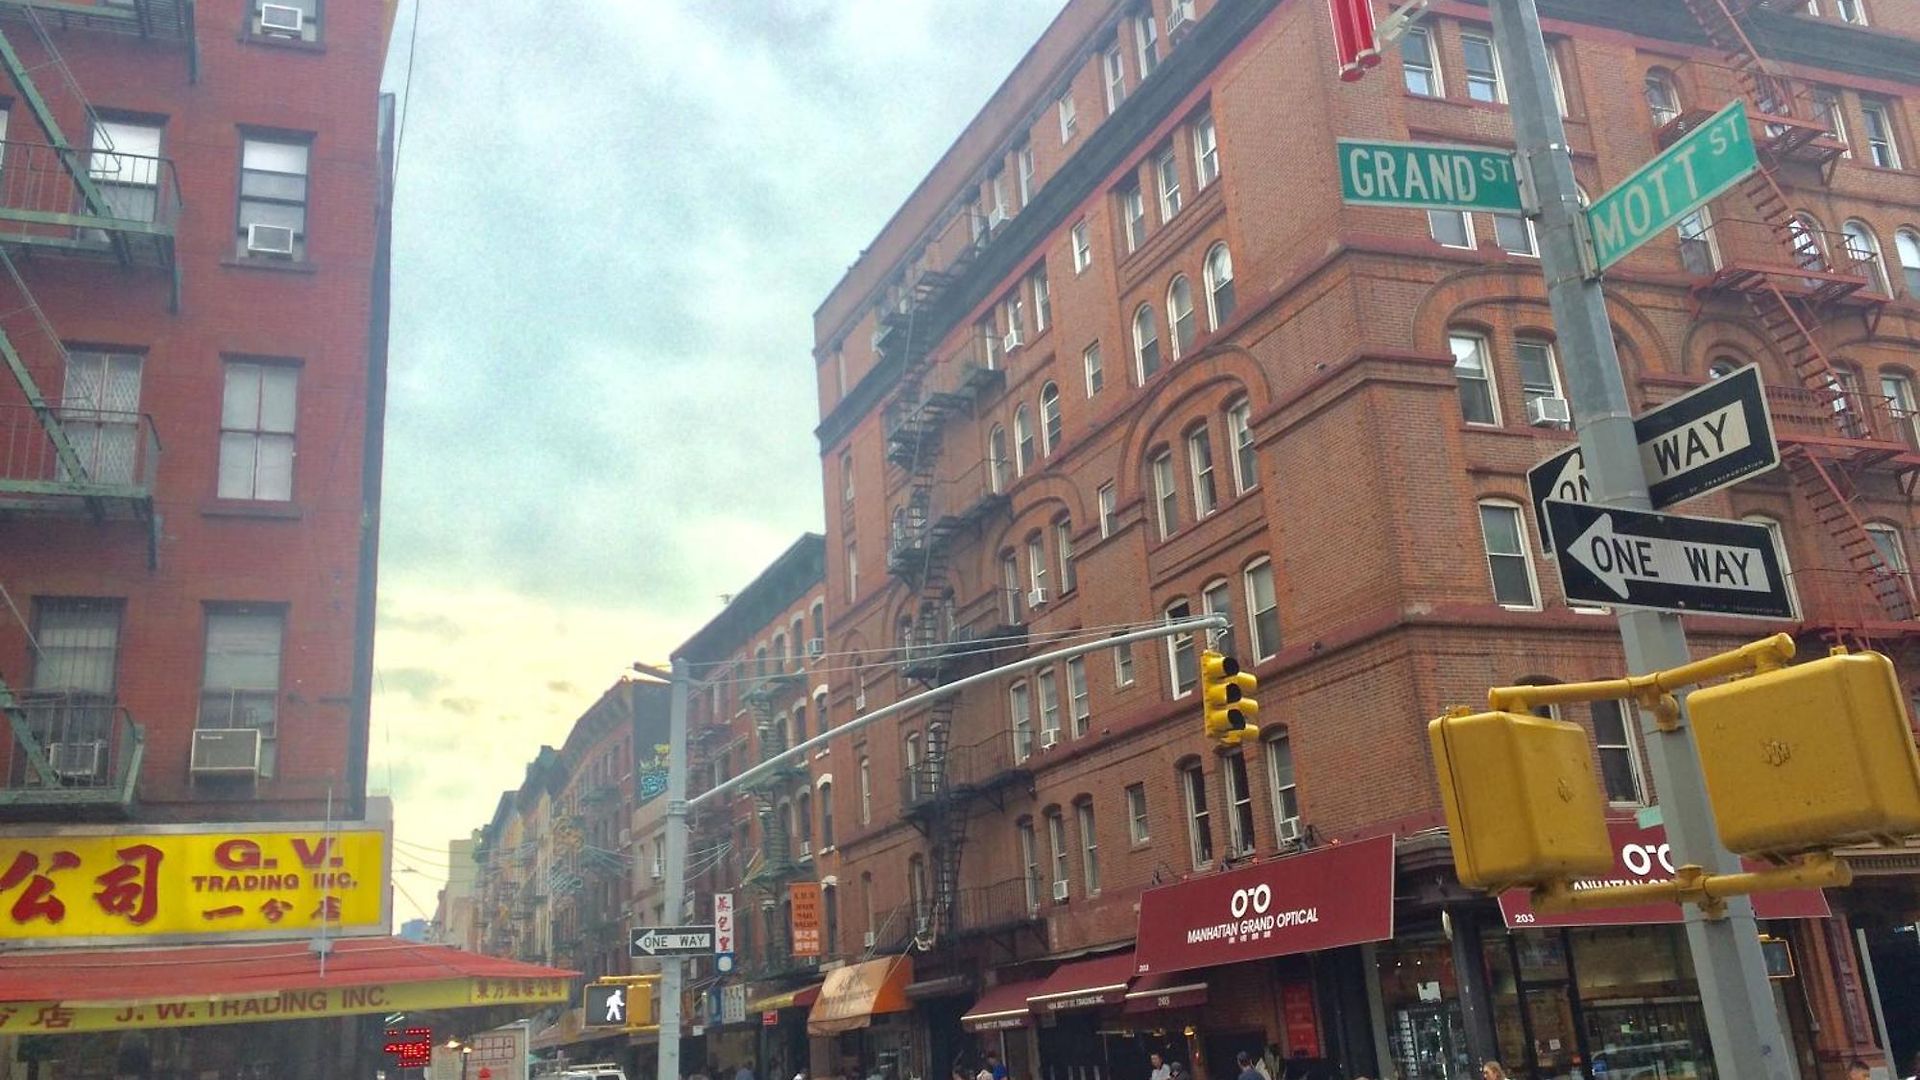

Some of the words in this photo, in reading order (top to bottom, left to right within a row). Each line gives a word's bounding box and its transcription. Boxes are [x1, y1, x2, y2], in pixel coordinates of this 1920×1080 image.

[1349, 148, 1477, 202] GRAND
[1480, 157, 1510, 183] ST
[1592, 143, 1697, 260] MOTT
[1708, 113, 1740, 156] ST
[1652, 412, 1729, 476] WAY
[1590, 536, 1660, 578] ONE
[1684, 546, 1750, 586] WAY
[214, 839, 278, 870] G.
[290, 837, 344, 869] V.
[0, 844, 164, 927] 公司
[191, 873, 299, 892] TRADING
[313, 871, 358, 889] INC.
[1187, 921, 1238, 944] MANHATTAN
[1240, 915, 1274, 935] GRAND
[1276, 907, 1319, 929] OPTICAL
[1514, 913, 1536, 923] 203
[643, 936, 668, 949] ONE
[680, 934, 705, 947] WAY
[115, 1006, 145, 1022] J.
[157, 1002, 195, 1020] W.
[208, 990, 328, 1018] TRADING
[342, 985, 391, 1009] INC.
